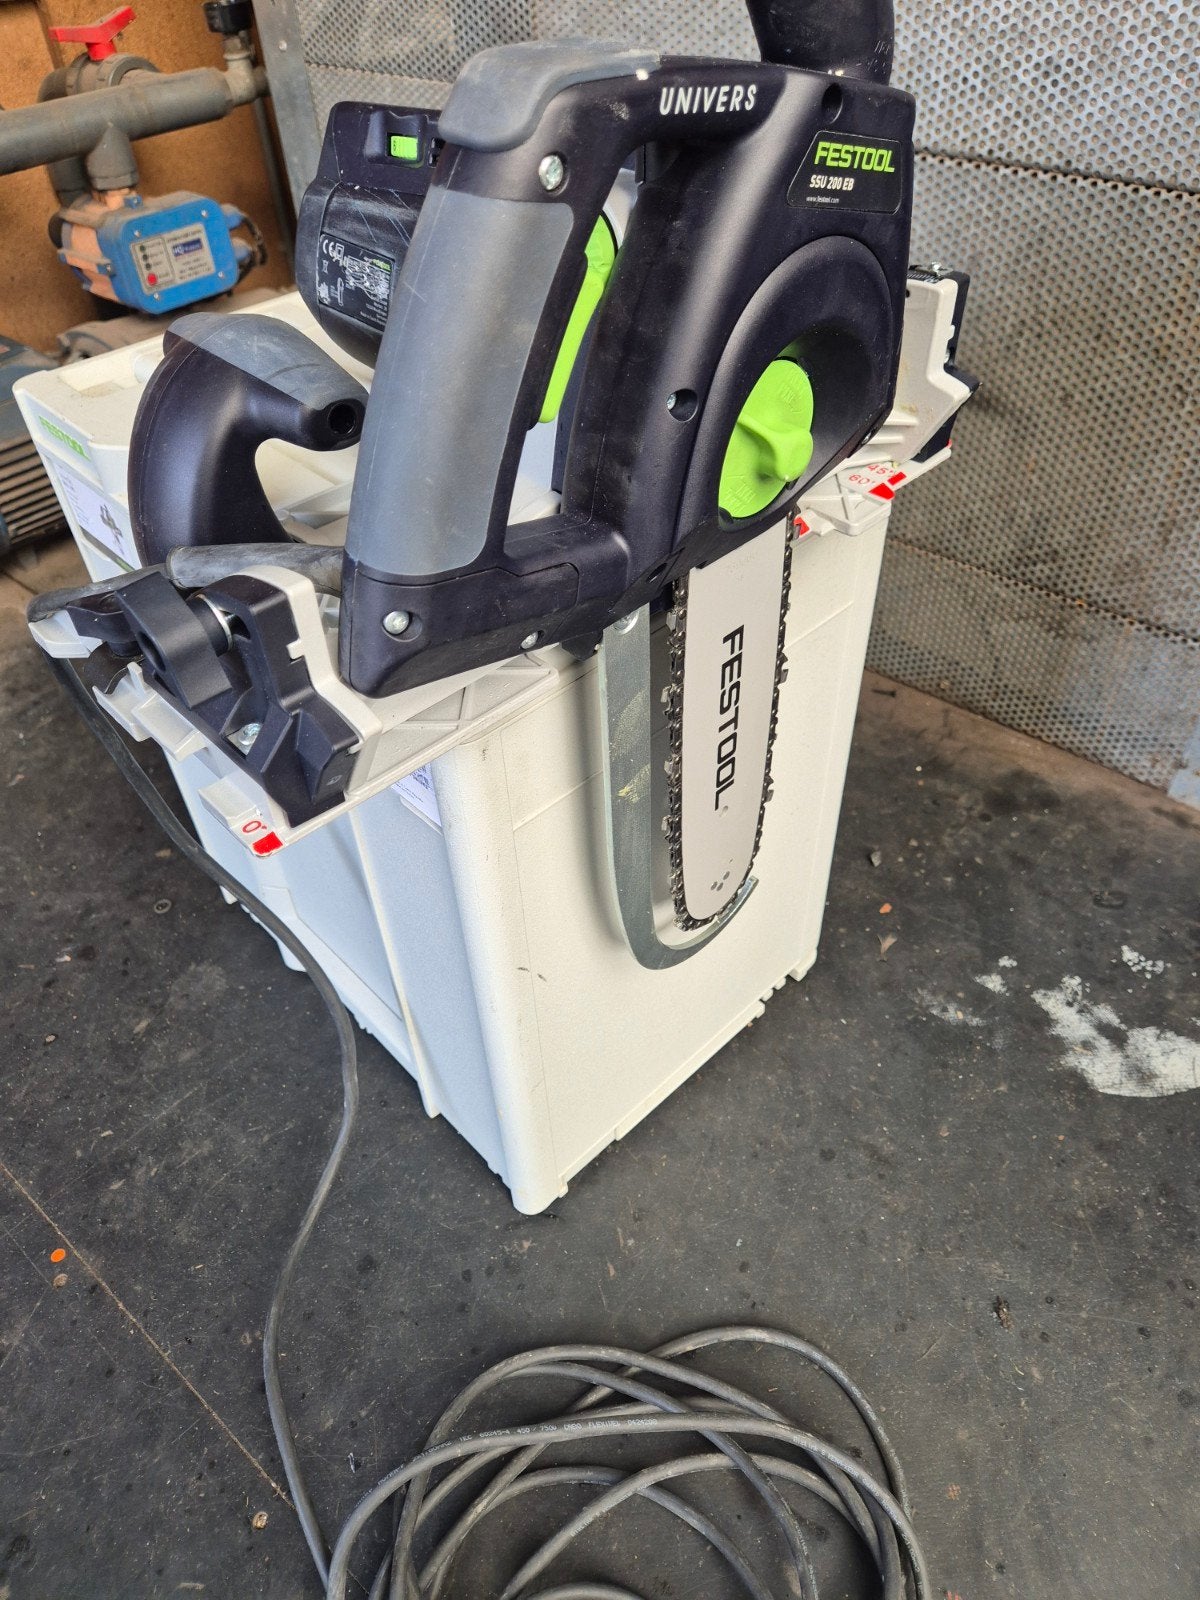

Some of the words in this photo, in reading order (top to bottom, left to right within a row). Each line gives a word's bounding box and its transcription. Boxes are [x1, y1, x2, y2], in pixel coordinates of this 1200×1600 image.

[660, 84, 757, 115] UNIVERS
[814, 141, 895, 173] FESTOOL
[809, 174, 827, 189] SSU
[826, 176, 842, 190] 200
[843, 177, 855, 191] EB
[714, 624, 745, 811] FESTOOL
